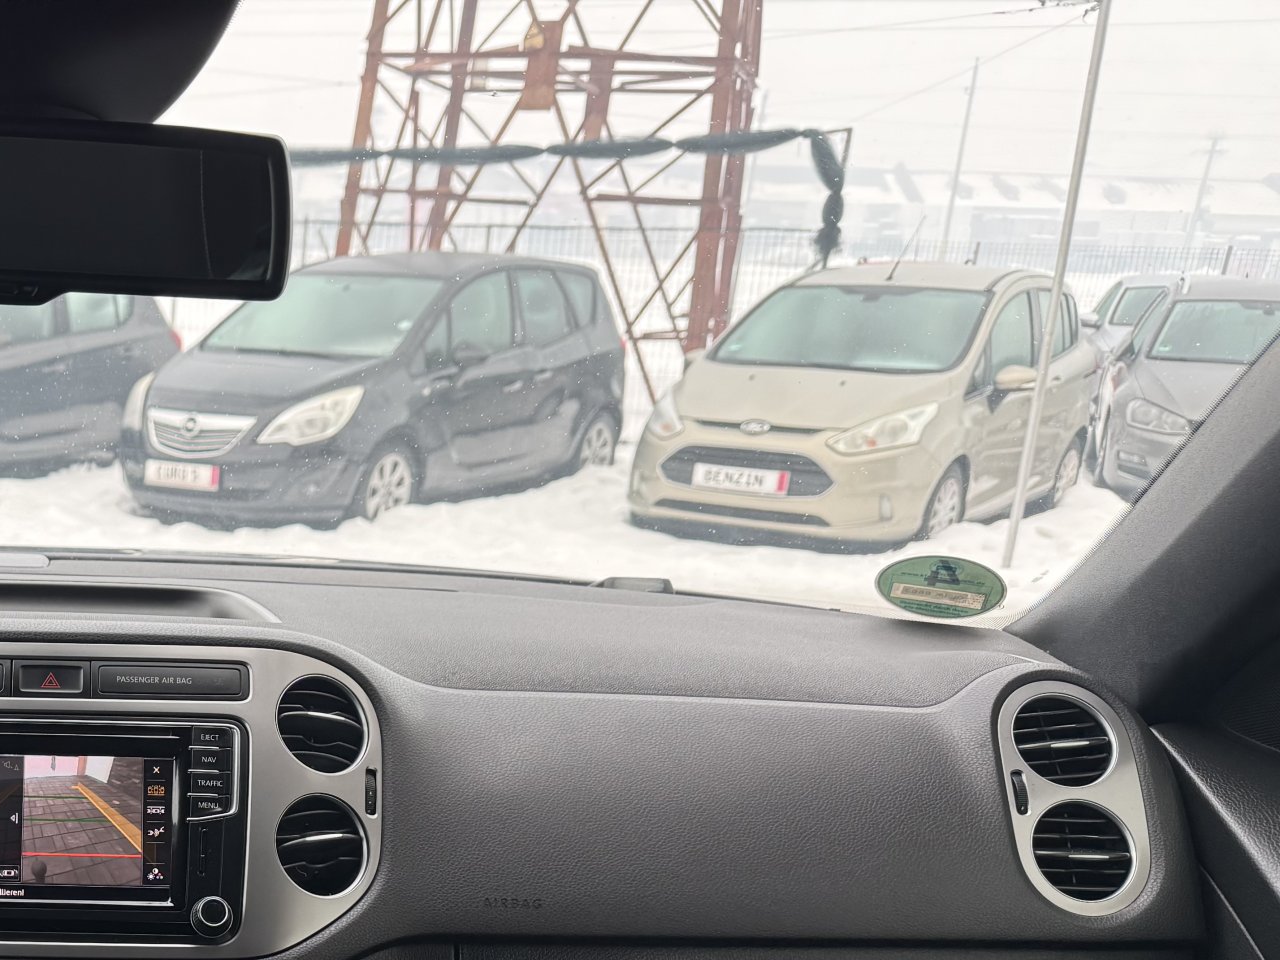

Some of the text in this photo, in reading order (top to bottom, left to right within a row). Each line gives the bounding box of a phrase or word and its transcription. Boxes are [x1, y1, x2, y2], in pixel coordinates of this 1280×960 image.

[704, 469, 765, 487] BENZIN
[116, 675, 160, 684] PASSENGER
[162, 676, 174, 684] AIR
[200, 733, 219, 741] EJECT
[197, 779, 223, 787] TRAFFIC
[198, 801, 219, 809] MENU
